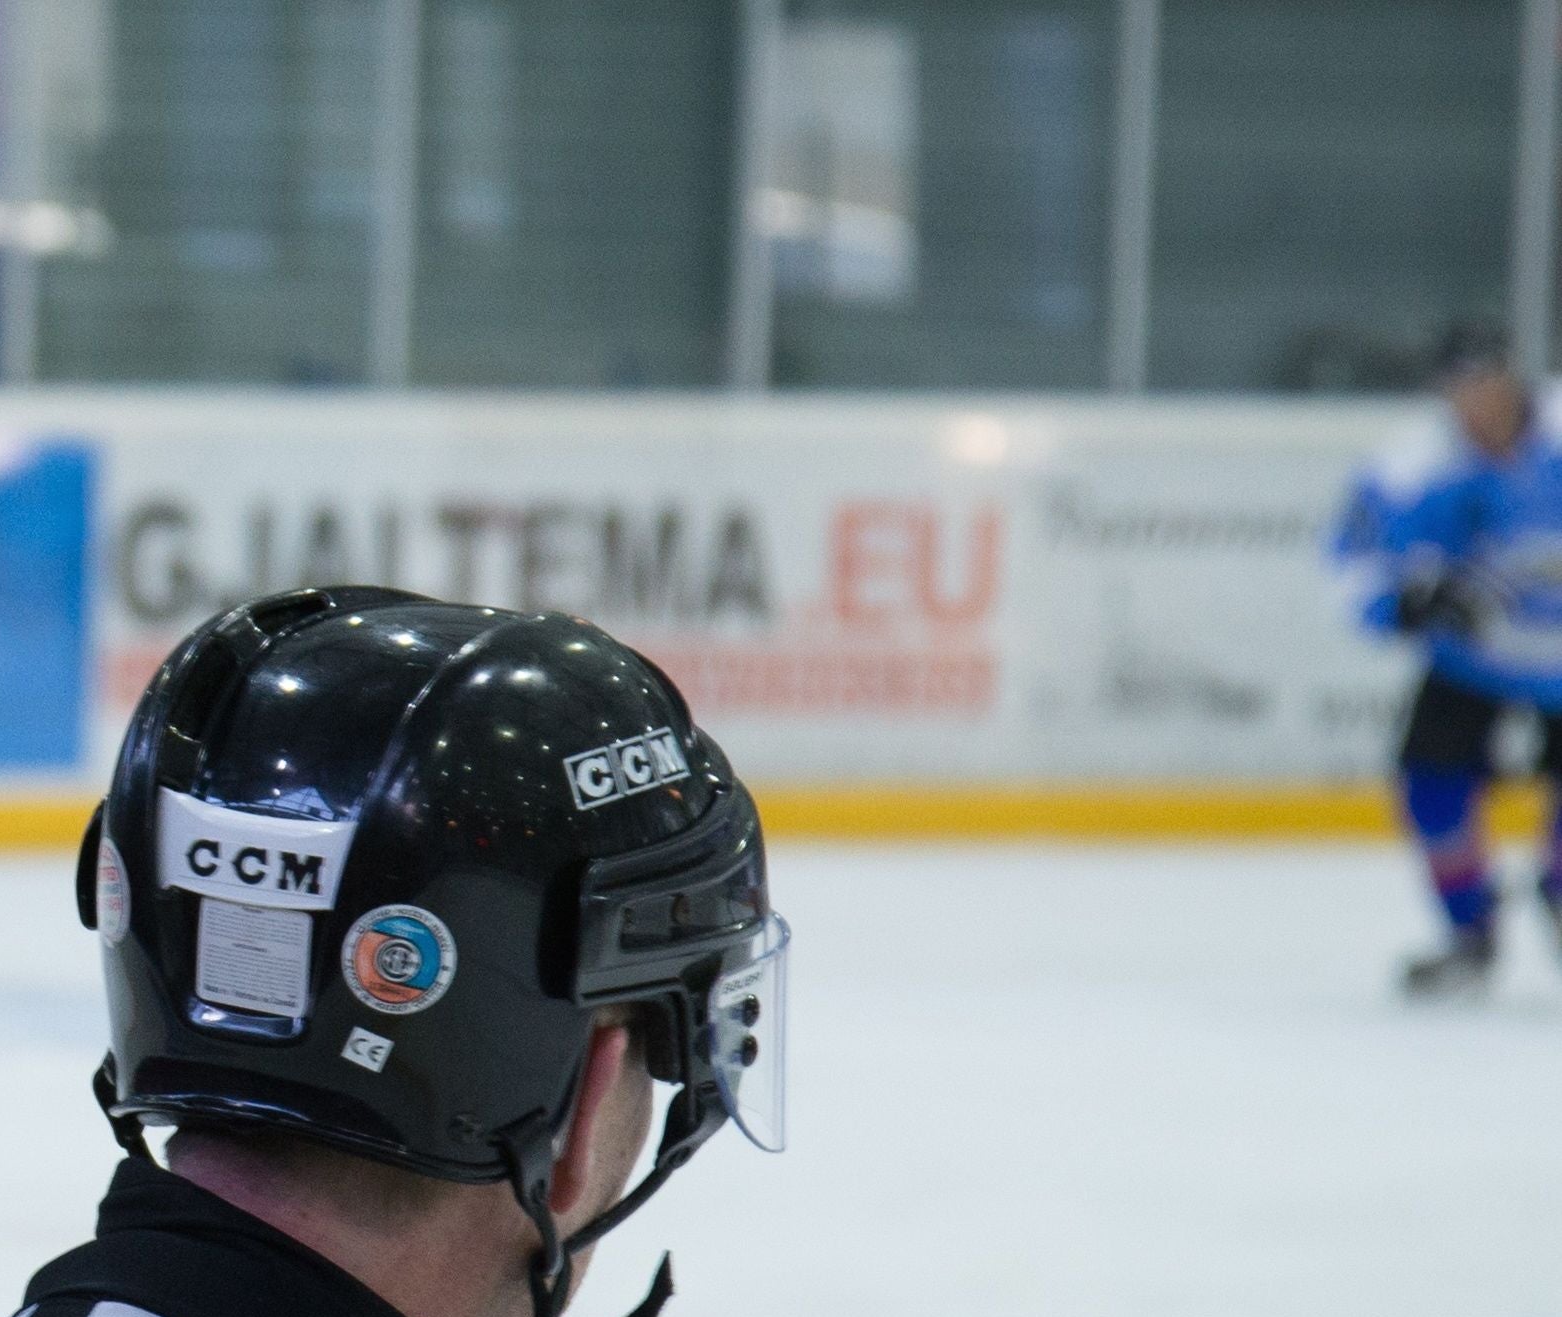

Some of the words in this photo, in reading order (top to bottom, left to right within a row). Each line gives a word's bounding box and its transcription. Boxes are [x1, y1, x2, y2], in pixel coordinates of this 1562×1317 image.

[574, 734, 685, 798] CCM
[186, 838, 324, 895] CCM
[349, 1037, 384, 1063] CE
